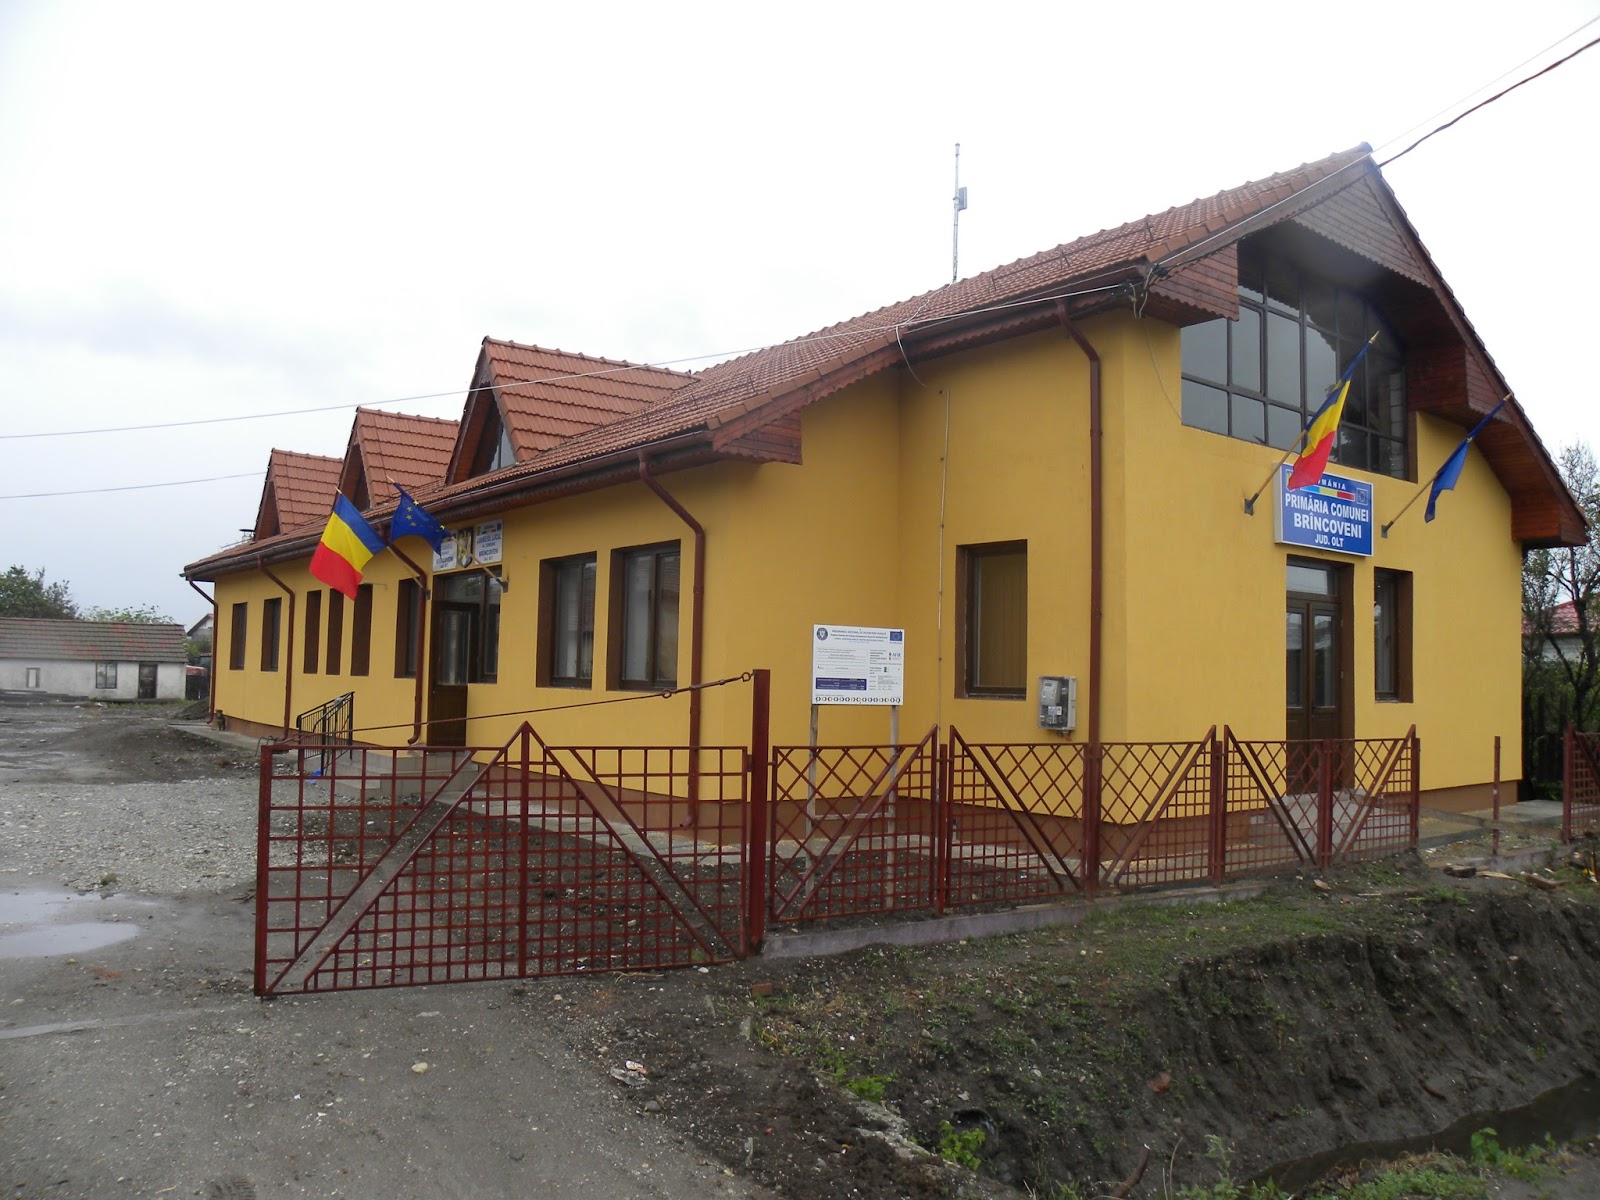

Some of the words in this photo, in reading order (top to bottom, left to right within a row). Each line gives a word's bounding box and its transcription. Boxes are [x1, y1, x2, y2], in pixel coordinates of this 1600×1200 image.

[1285, 493, 1329, 515] PRIMĂRIA
[1331, 502, 1369, 522] COMUNEI
[1293, 512, 1362, 539] BRÎNCOVENI
[1314, 534, 1330, 545] JUD.
[1331, 536, 1344, 547] OLT
